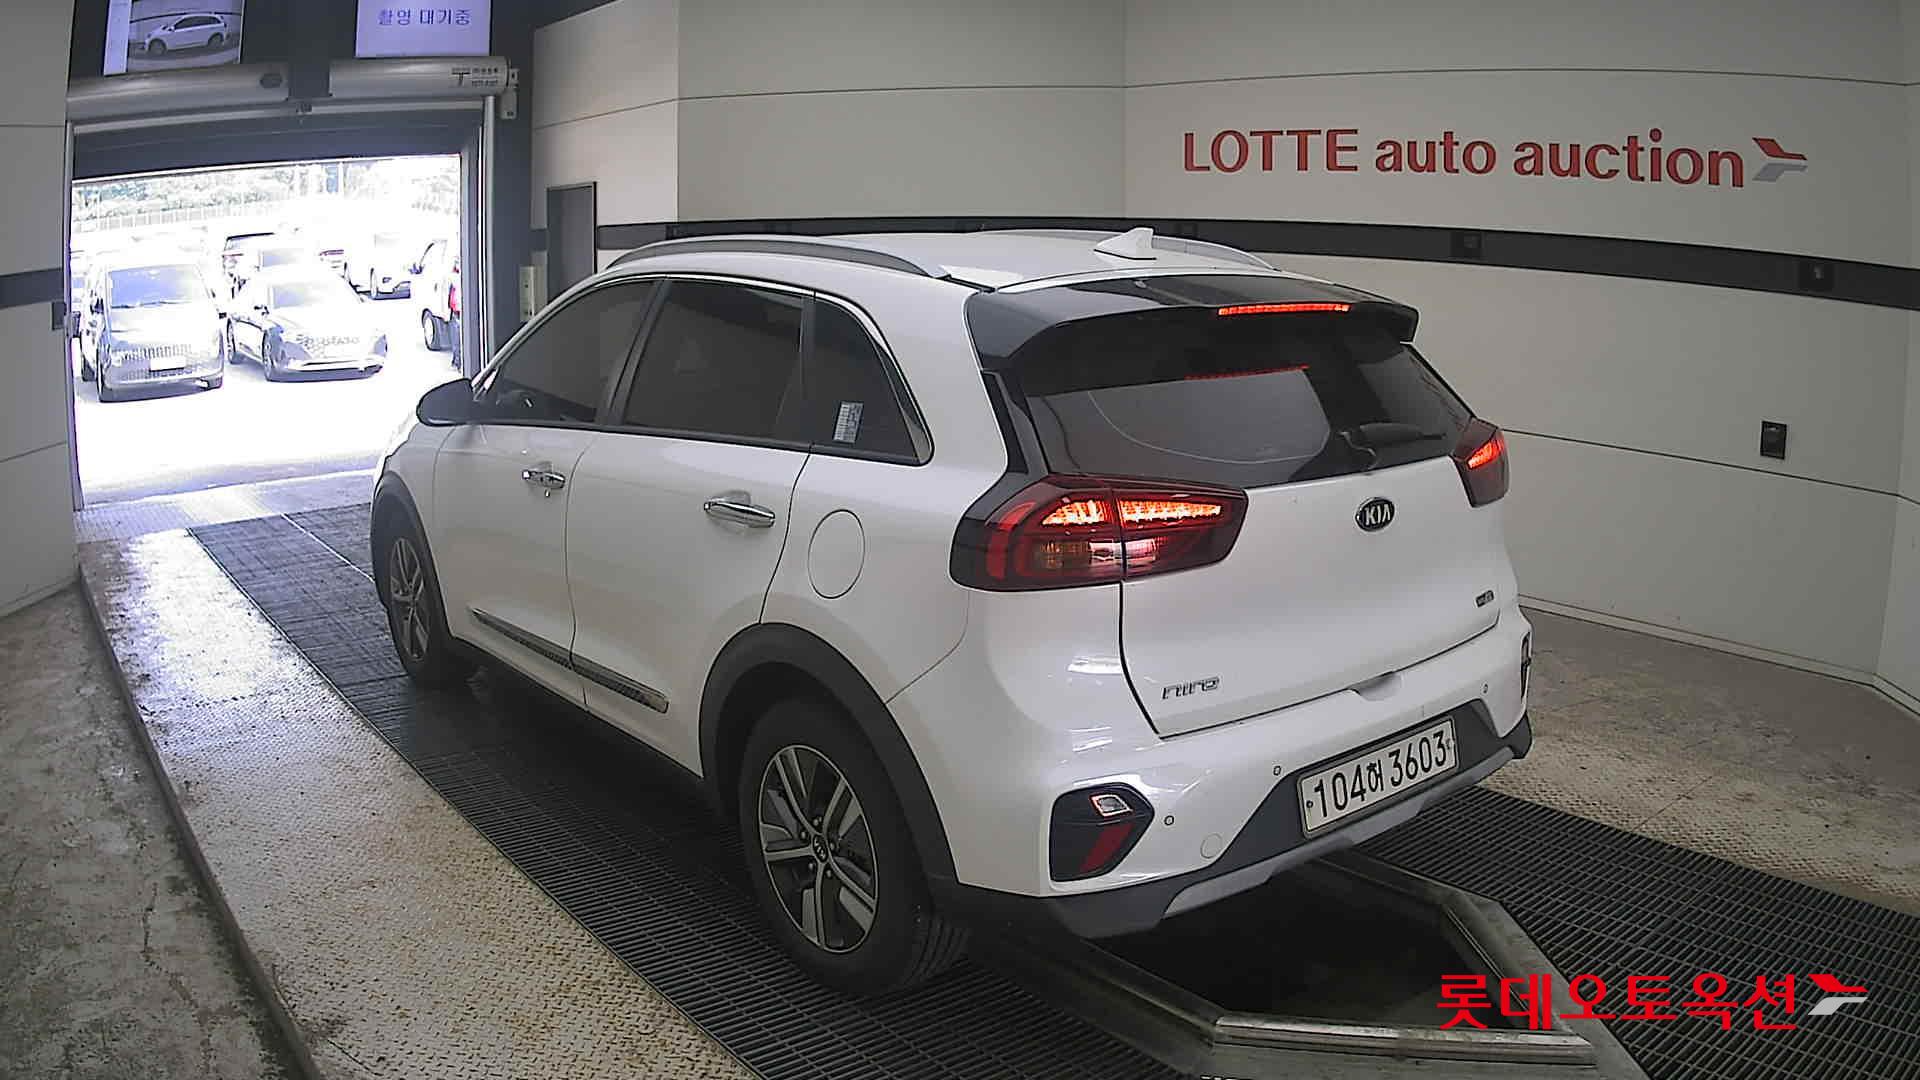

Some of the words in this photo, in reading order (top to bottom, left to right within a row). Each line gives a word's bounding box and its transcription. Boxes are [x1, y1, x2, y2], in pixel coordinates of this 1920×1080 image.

[419, 9, 470, 26] 대기중
[1183, 128, 1358, 172] LOTTE
[1376, 131, 1497, 175] auto
[1513, 129, 1744, 187] auction
[1364, 503, 1391, 525] KIA
[1314, 759, 1384, 818] 104허
[1388, 730, 1447, 788] 3603
